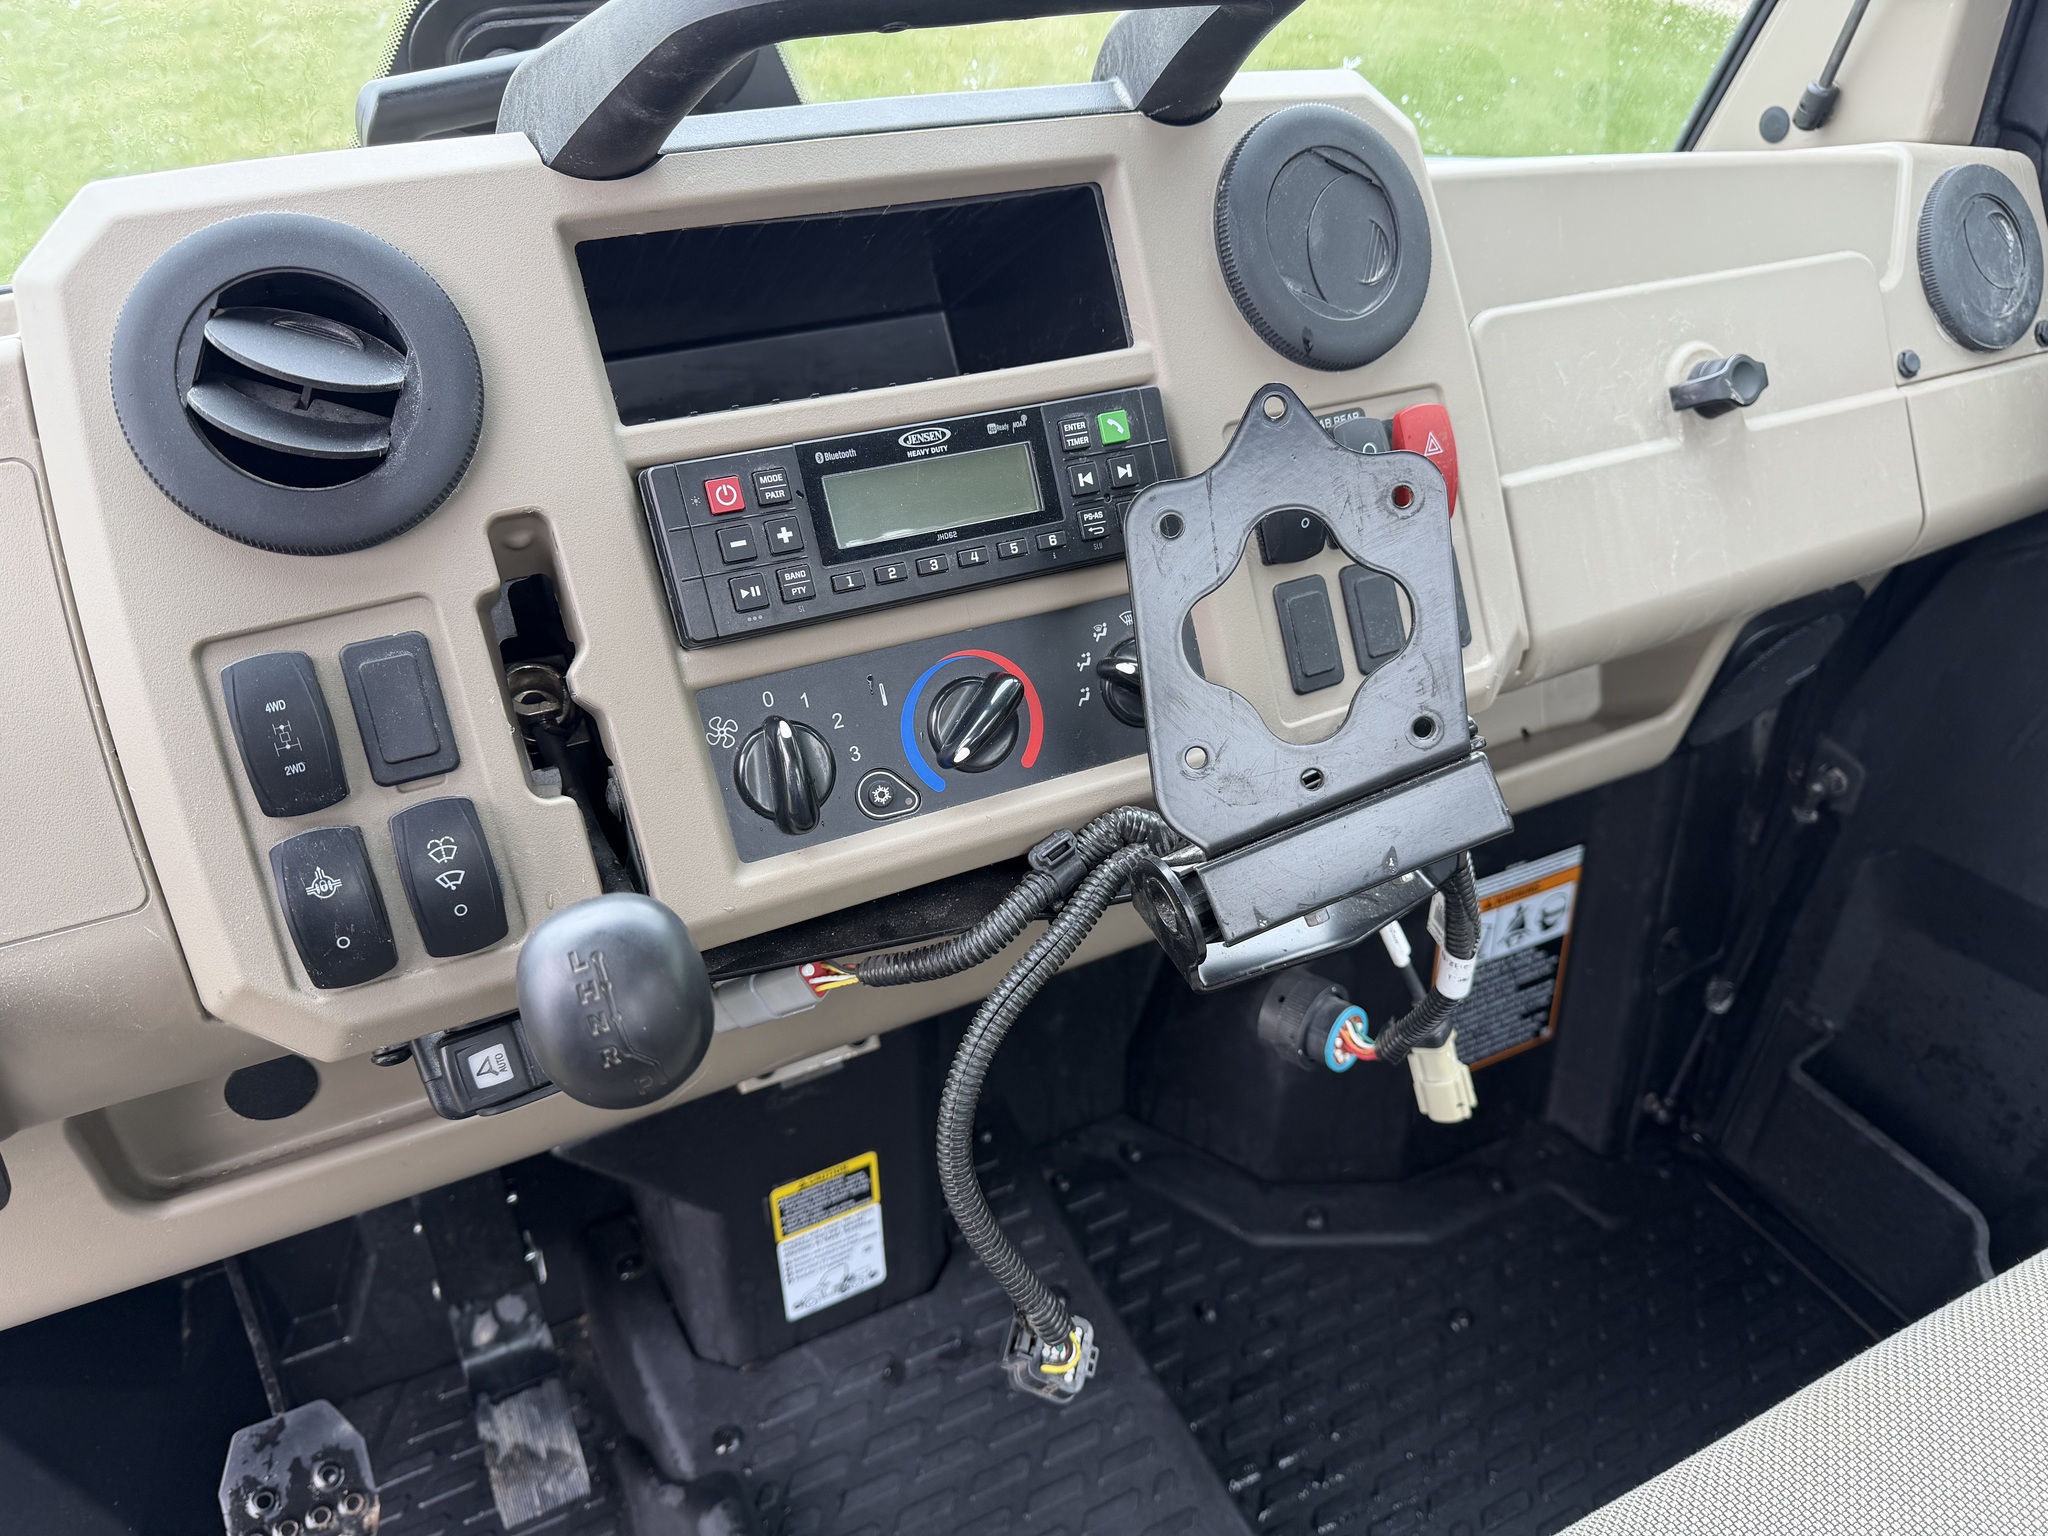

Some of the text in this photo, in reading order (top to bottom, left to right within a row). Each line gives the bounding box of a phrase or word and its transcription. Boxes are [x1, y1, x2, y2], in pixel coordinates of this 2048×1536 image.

[1063, 420, 1086, 432] ENTER
[905, 430, 943, 446] JENSEN
[1066, 436, 1090, 447] TIMER
[824, 448, 857, 462] Bluetooth
[907, 445, 949, 458] HEAVY DUTY
[759, 473, 783, 485] MODE
[765, 489, 785, 500] PAIR
[846, 534, 1058, 587] 1 2 3 4 5 6
[784, 569, 807, 580] BAND
[791, 585, 807, 596] PTY
[265, 699, 287, 713] 4WD
[762, 690, 774, 708] 0
[800, 692, 809, 708] 1
[832, 712, 845, 730] 2
[849, 745, 862, 762] 3
[284, 762, 306, 776] 2WD
[568, 950, 589, 973] L
[575, 978, 601, 1005] H
[587, 1011, 611, 1036] N
[495, 1052, 508, 1073] AUTO
[600, 1045, 623, 1069] R
[633, 1075, 654, 1096] P
